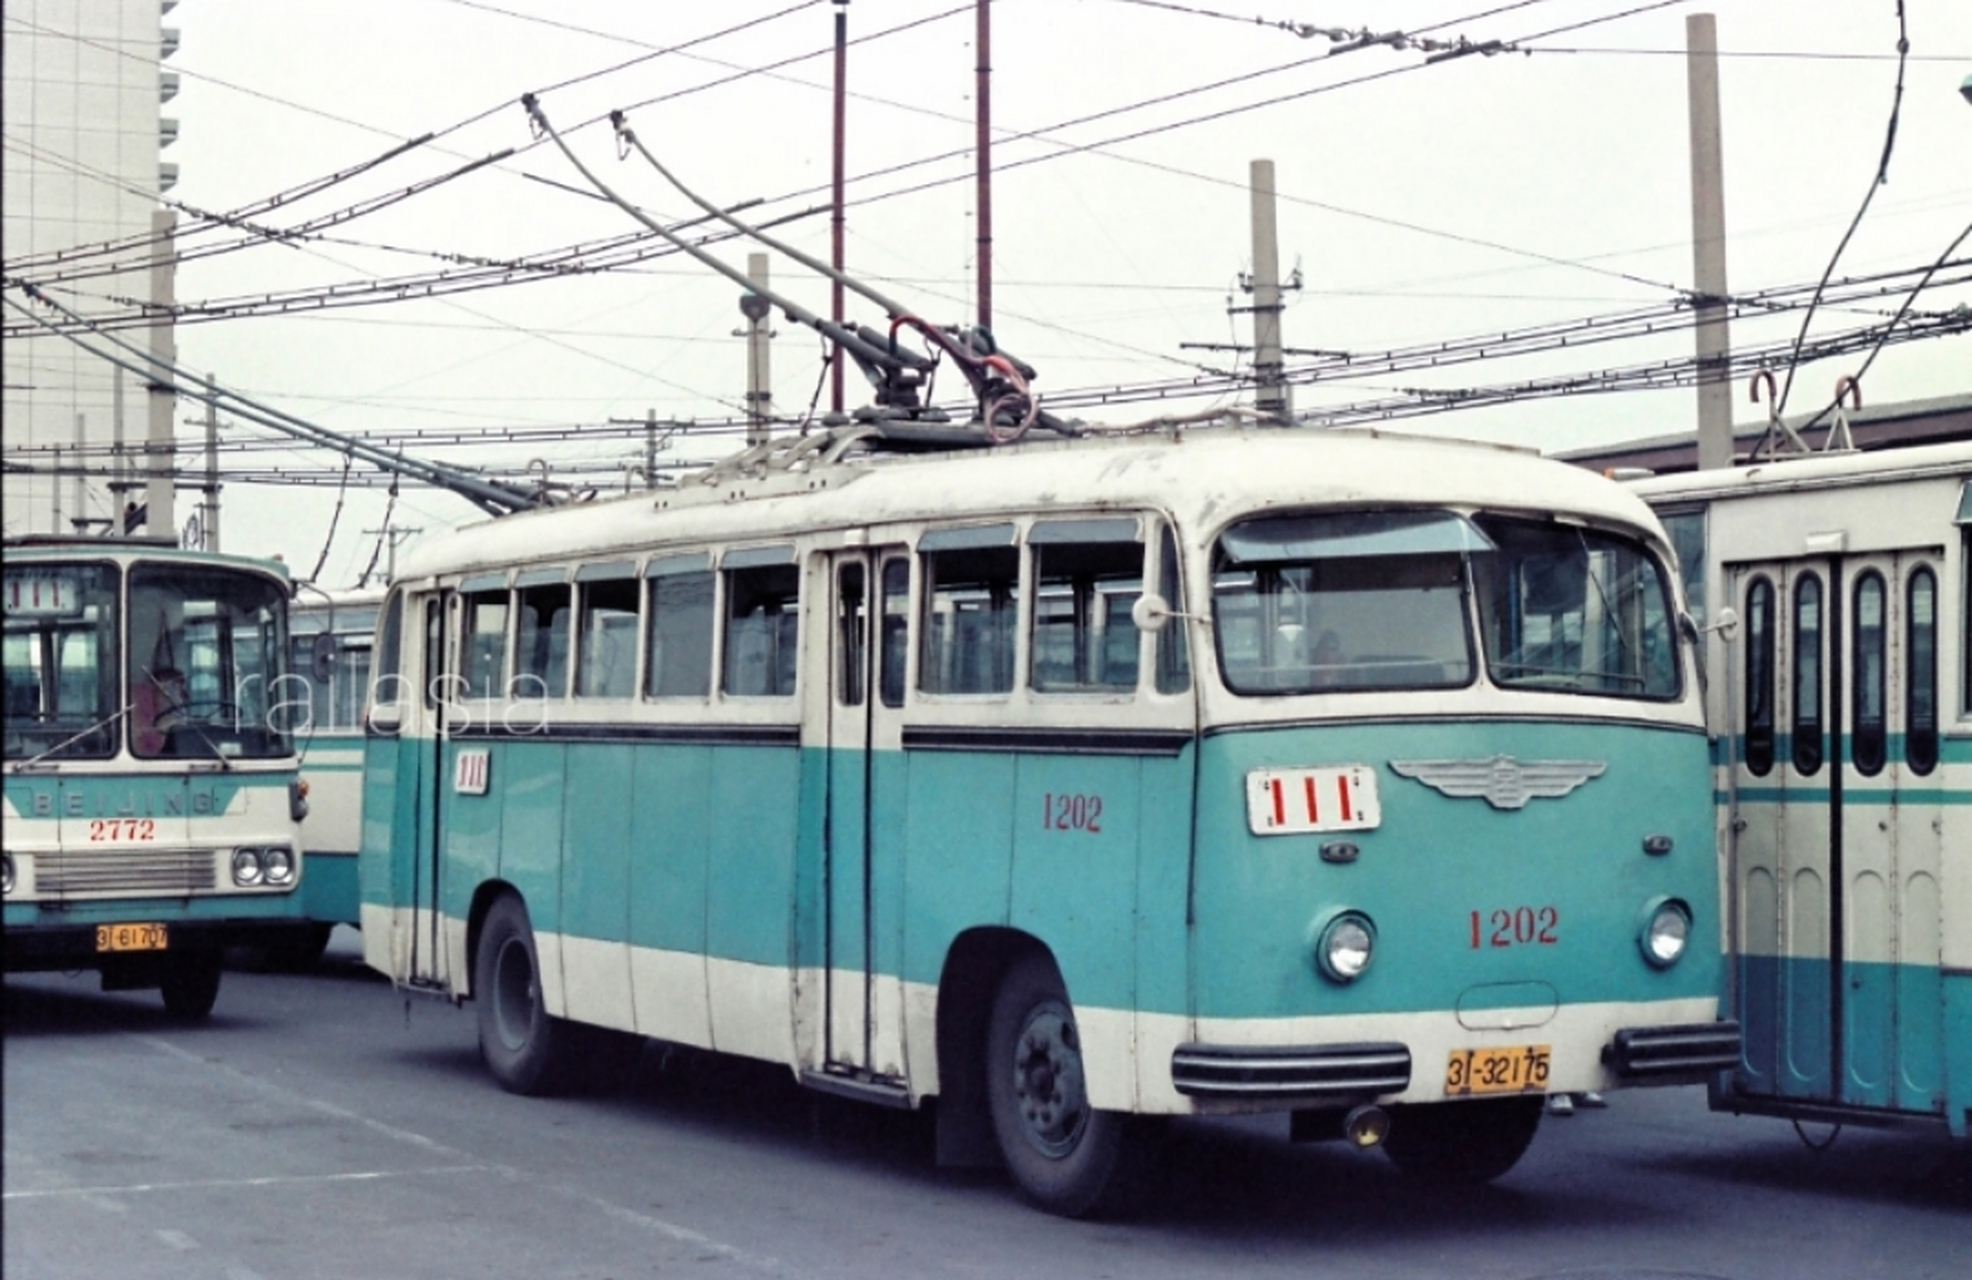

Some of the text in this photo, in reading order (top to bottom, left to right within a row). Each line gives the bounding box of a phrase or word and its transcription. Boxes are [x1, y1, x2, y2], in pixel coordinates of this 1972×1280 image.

[33, 793, 212, 818] BEIJING
[1044, 792, 1102, 833] 1202
[1272, 775, 1351, 825] 111
[90, 819, 154, 841] 2772
[1471, 906, 1558, 949] 1202
[1448, 1052, 1550, 1086] 31-32175
